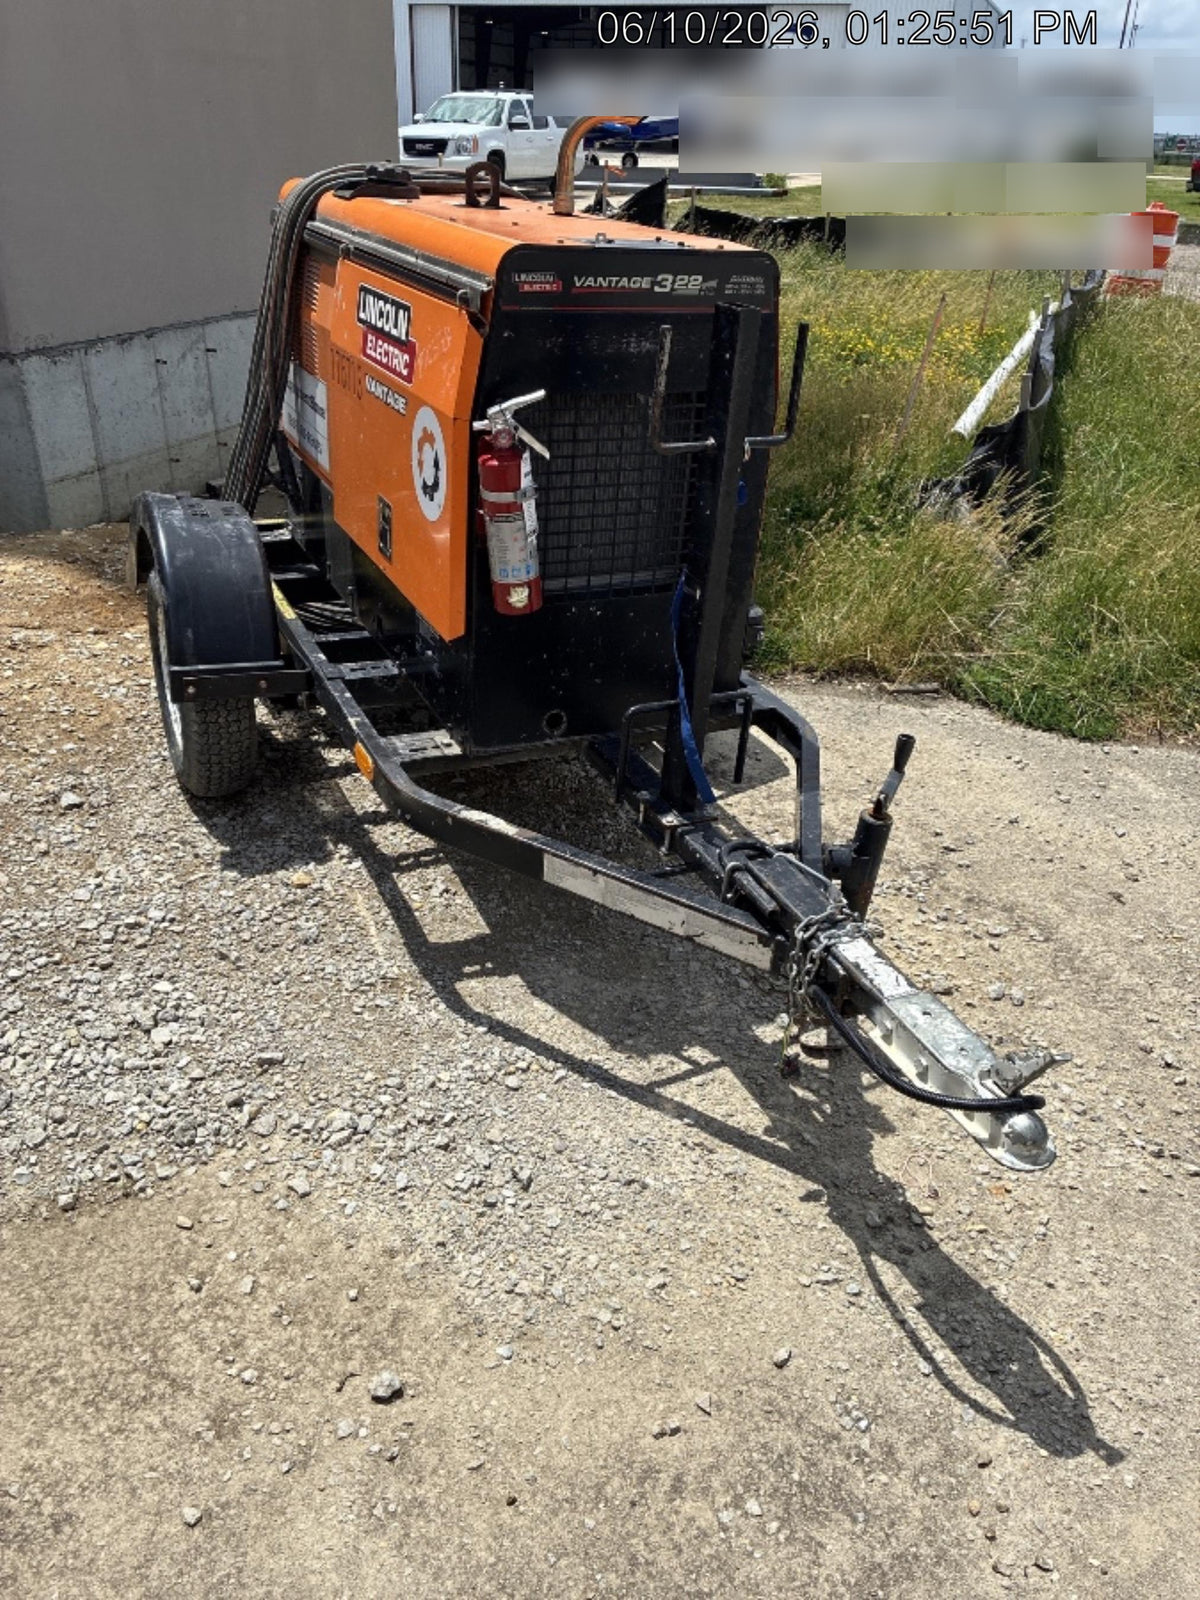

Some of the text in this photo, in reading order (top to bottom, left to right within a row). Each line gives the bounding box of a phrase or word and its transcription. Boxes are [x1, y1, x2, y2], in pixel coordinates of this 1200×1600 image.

[573, 273, 703, 293] VANTAGE 322
[358, 290, 410, 342] LINCOLN
[365, 333, 411, 377] ELECTRIC
[364, 372, 408, 417] VANTAGE
